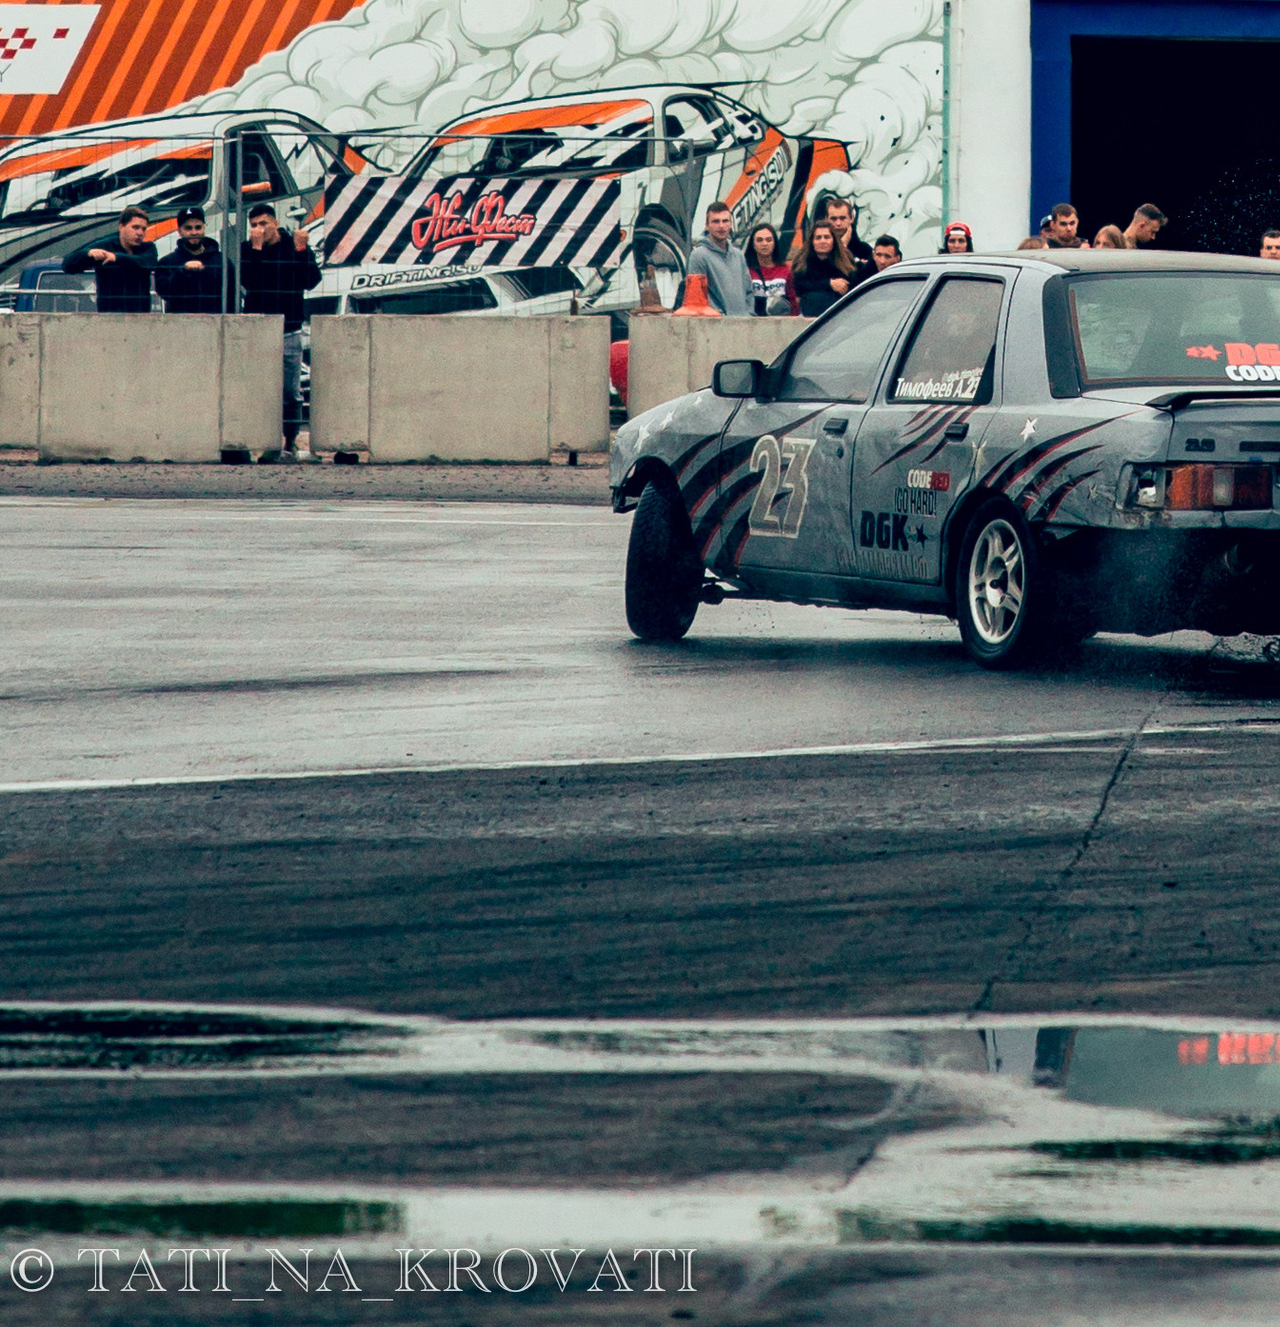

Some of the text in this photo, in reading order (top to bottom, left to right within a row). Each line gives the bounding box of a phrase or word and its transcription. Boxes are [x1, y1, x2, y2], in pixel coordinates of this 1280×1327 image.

[894, 377, 955, 400] Тимофеев
[748, 434, 817, 539] 23
[860, 510, 909, 551] DGK
